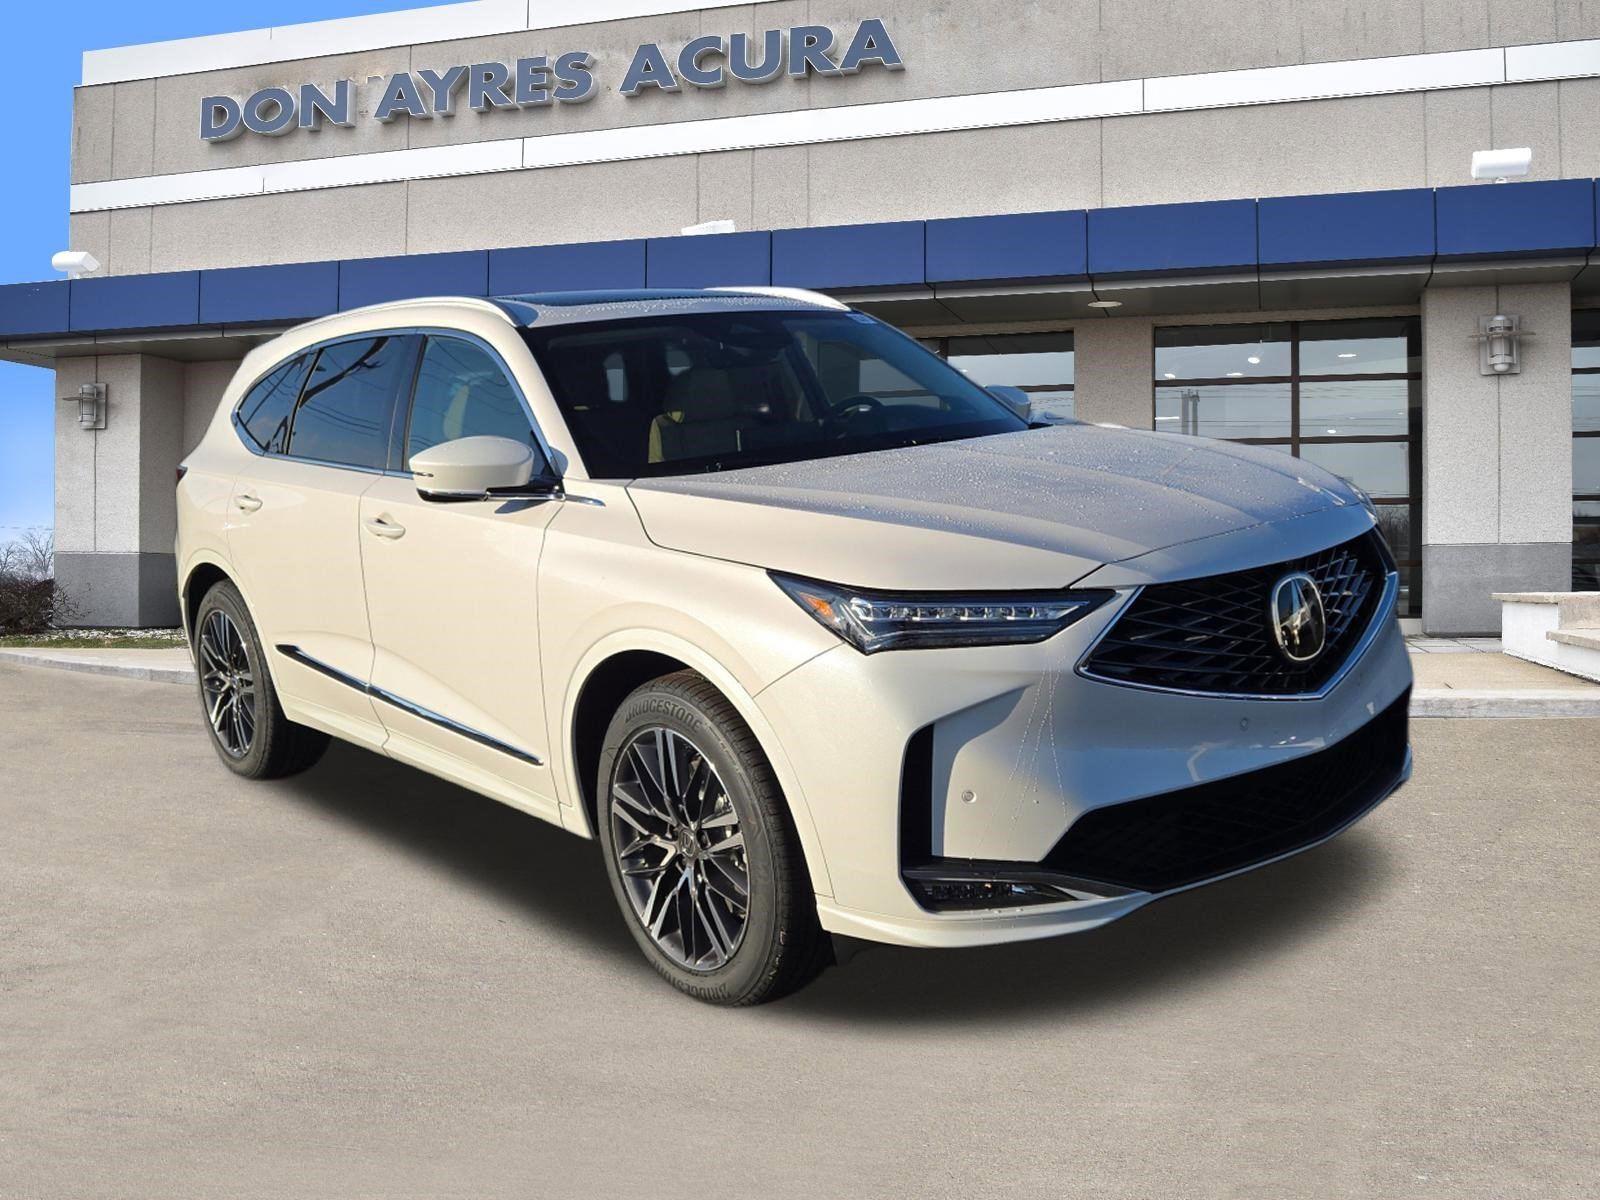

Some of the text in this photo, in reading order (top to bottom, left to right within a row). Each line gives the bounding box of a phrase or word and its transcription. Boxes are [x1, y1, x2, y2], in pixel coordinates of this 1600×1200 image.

[200, 17, 905, 143] DON AYRES ACURA
[624, 698, 703, 733] BRIDGESTONE
